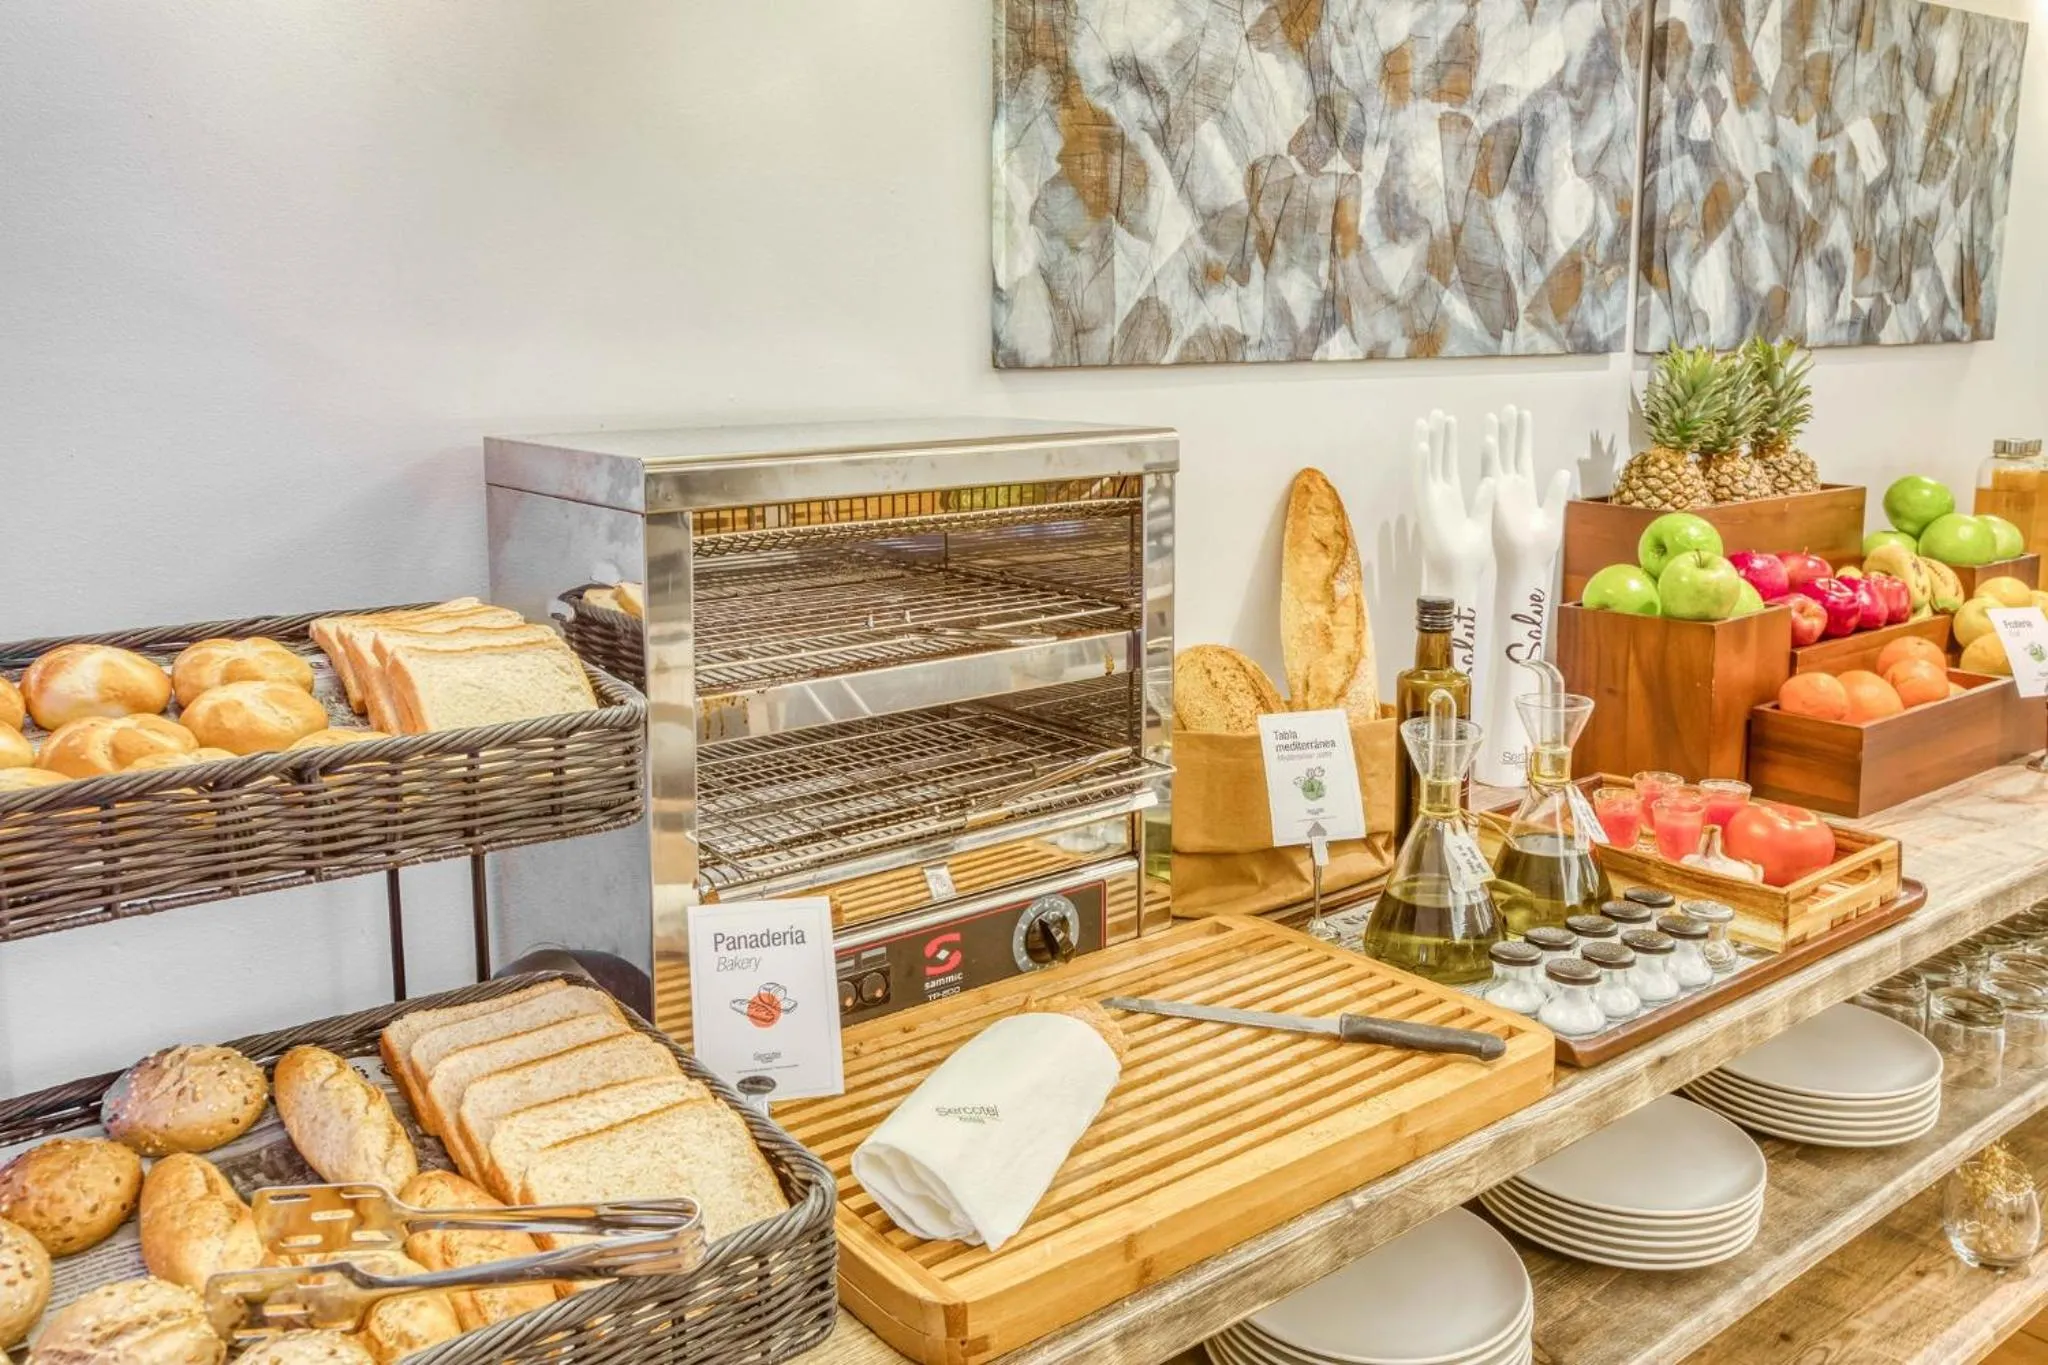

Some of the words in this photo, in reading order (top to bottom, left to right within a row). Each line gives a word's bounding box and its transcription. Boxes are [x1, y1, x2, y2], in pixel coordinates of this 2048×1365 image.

[1505, 587, 1545, 664] Salve
[1272, 729, 1298, 741] Tabla
[1275, 739, 1337, 752] mediterránea
[713, 924, 807, 952] Panadería
[716, 956, 761, 973] Bakery
[924, 972, 963, 991] sammic
